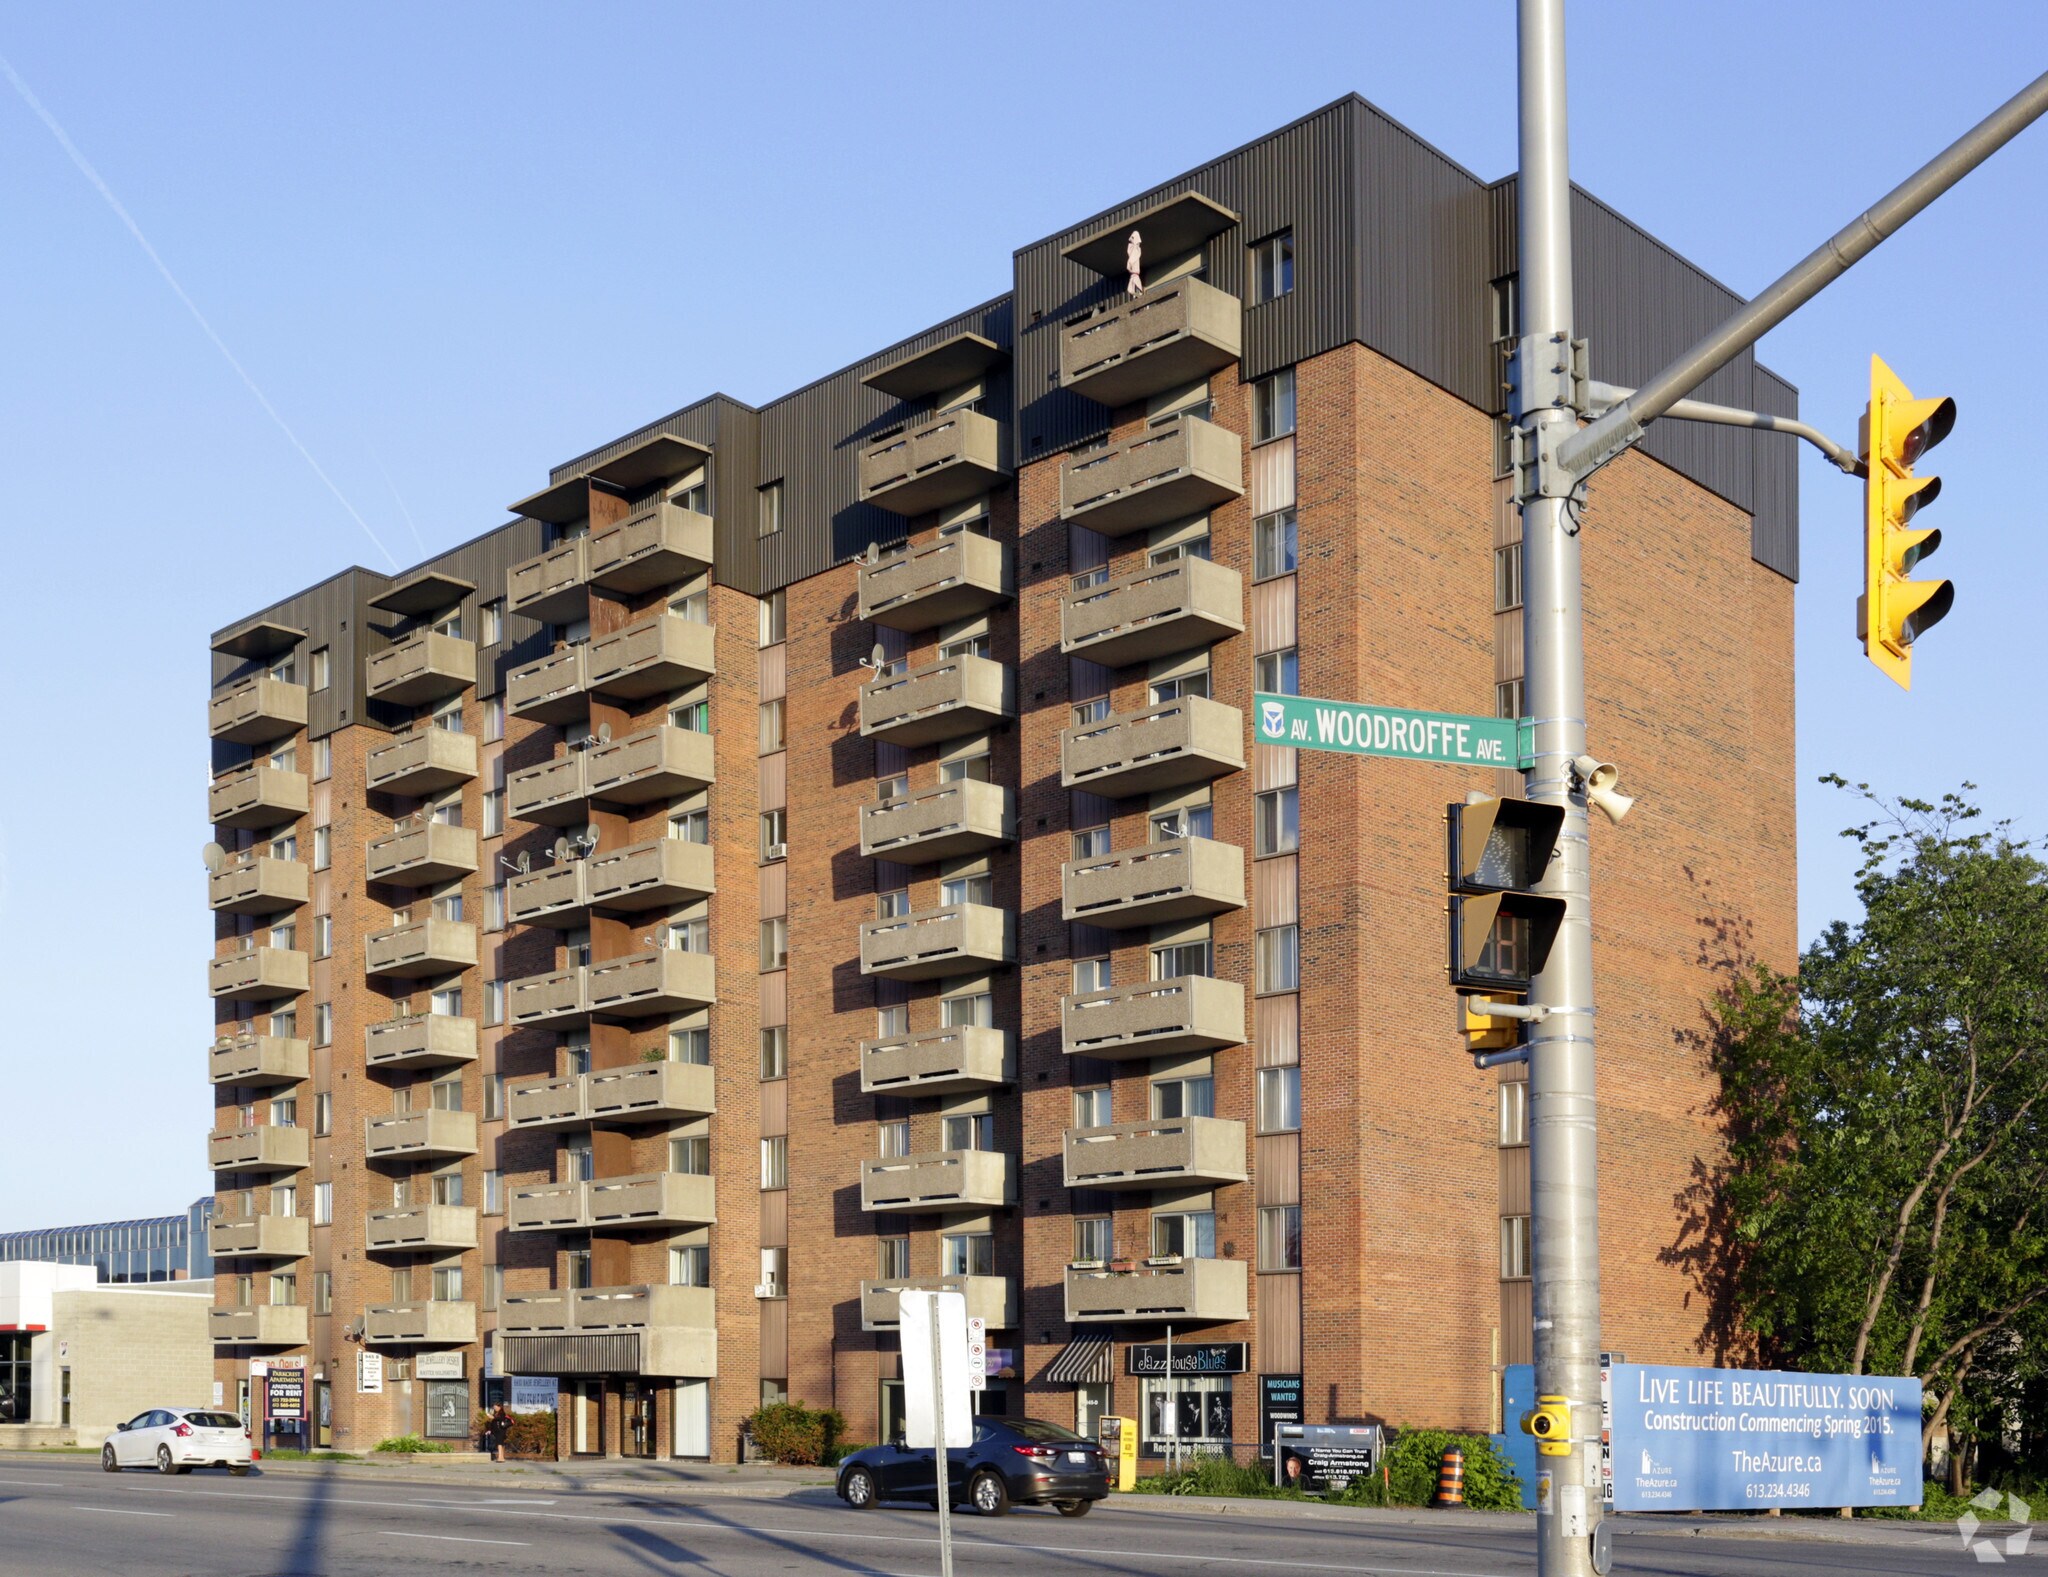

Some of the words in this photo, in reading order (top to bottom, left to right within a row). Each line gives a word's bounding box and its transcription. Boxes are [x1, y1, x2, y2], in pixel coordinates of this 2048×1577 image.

[1290, 718, 1312, 742] AV.
[1316, 708, 1471, 758] WOODROFFE
[1476, 738, 1506, 761] AVE.
[1267, 1380, 1300, 1388] MUSICIANS
[1270, 1392, 1296, 1401] WANTED
[1688, 1380, 1724, 1405] LIFE
[1732, 1382, 1844, 1408] BEAUTIFULLY.
[1849, 1387, 1898, 1410] SOON.
[1645, 1410, 1736, 1431] Construction
[1740, 1413, 1821, 1438] Commencing
[1825, 1415, 1861, 1438] Spring
[1864, 1416, 1894, 1434] 2015.
[1732, 1450, 1822, 1472] TheAzure.ca
[1636, 1478, 1677, 1487] TheAzure.ca
[1869, 1477, 1901, 1485] TheAzure.ca
[1746, 1483, 1810, 1498] 613.234.4346
